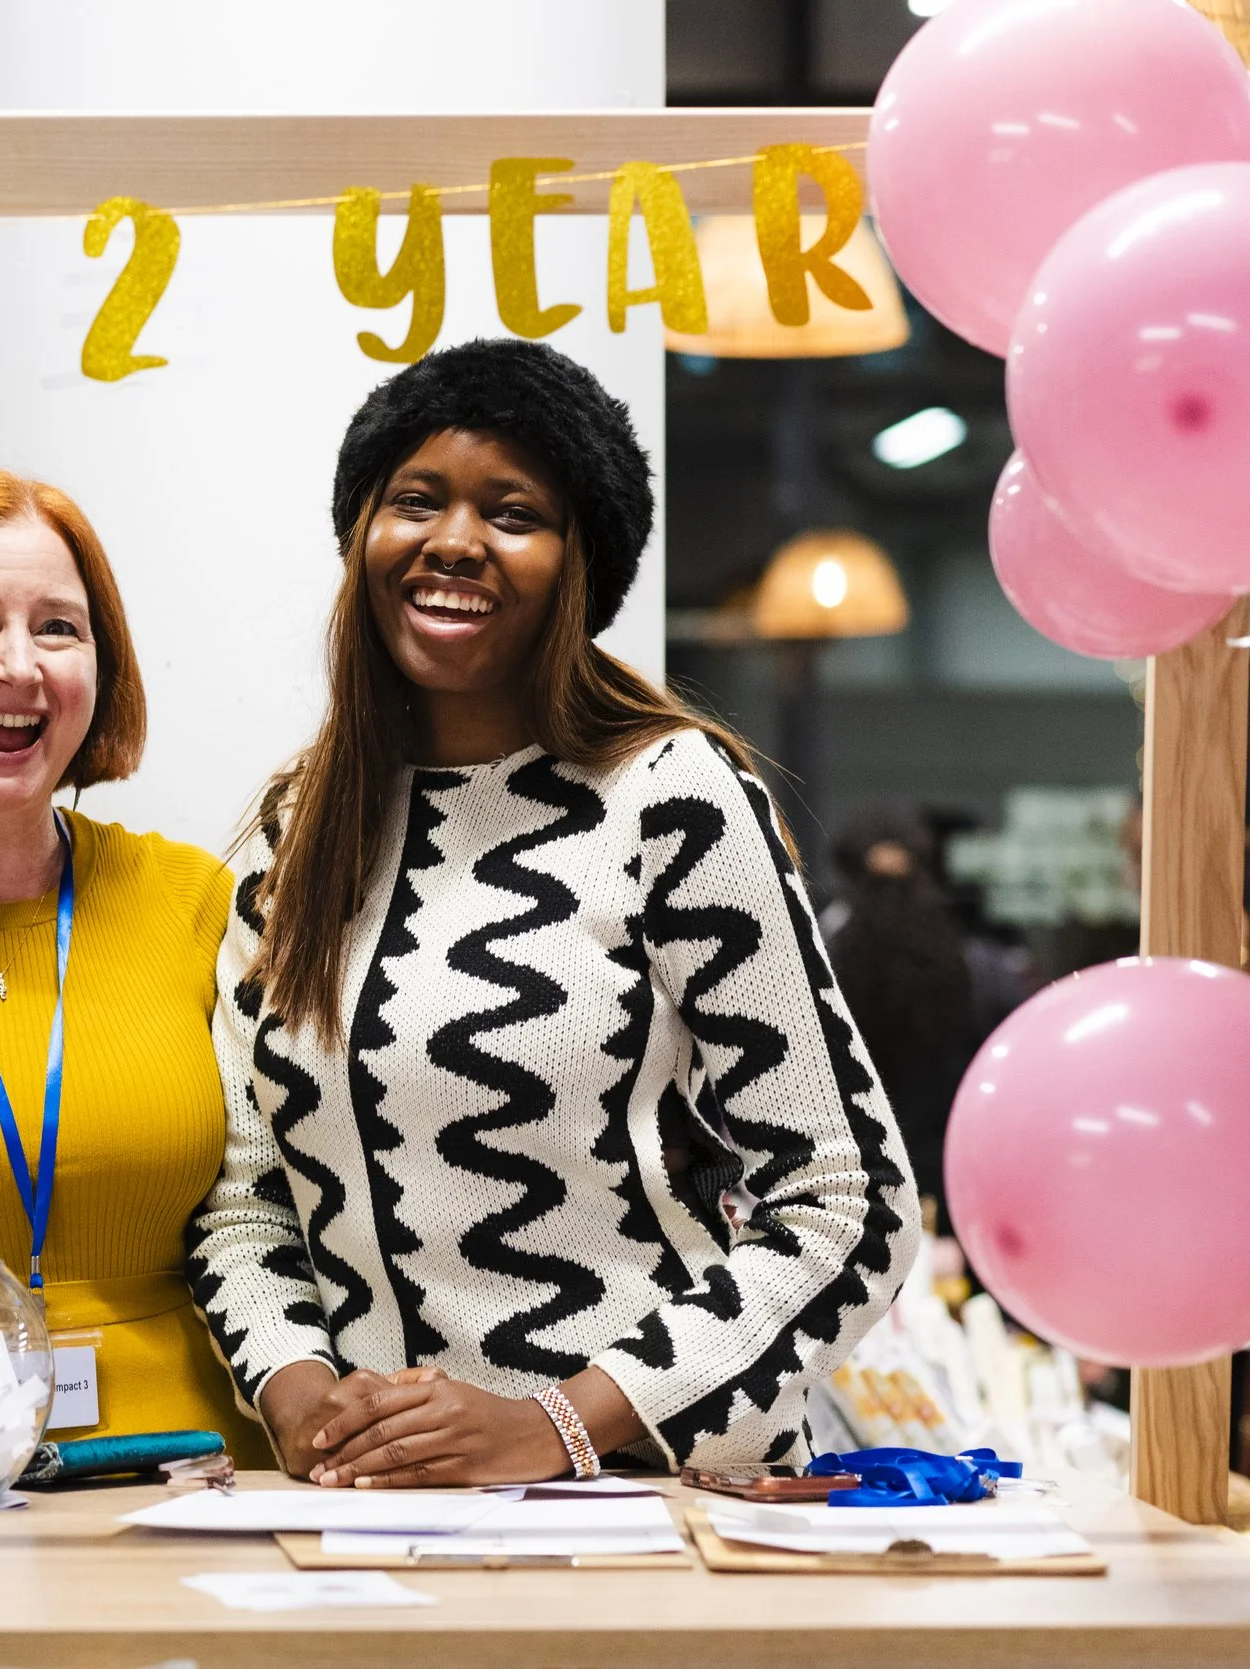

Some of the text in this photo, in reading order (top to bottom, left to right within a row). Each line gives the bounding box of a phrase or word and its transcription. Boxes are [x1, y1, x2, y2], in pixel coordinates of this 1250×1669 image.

[81, 197, 181, 382] 2
[54, 1379, 89, 1394] mpact 3
